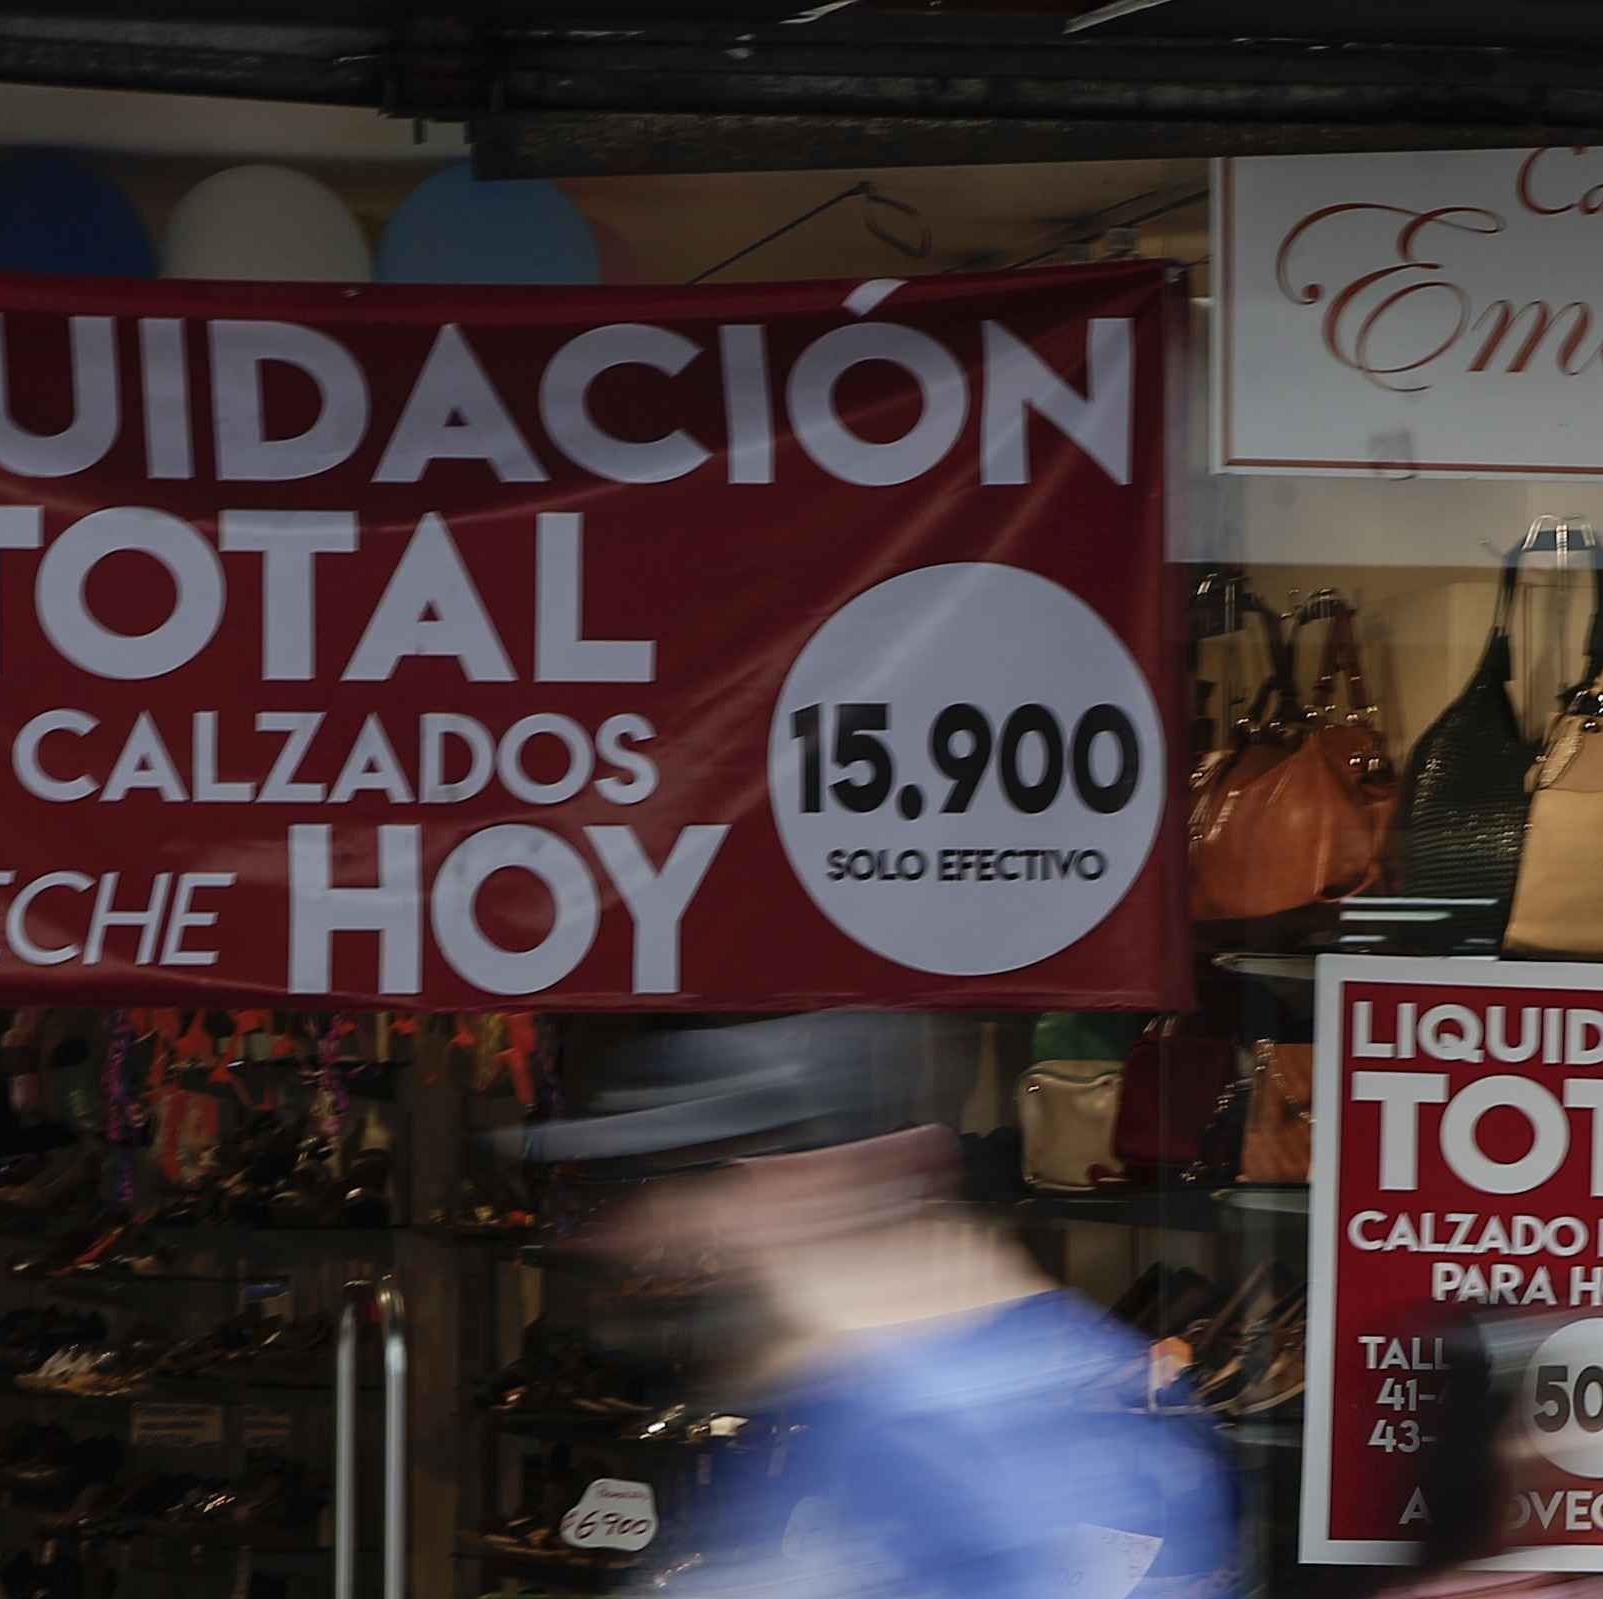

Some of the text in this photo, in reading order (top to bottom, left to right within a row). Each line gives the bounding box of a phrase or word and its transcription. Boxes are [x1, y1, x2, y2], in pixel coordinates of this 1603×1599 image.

[11, 708, 660, 806] CALZADOS
[825, 847, 1107, 883] SOLO EFECTIVO
[287, 822, 731, 996] HOY
[1347, 1210, 1590, 1257] CALZADO
[1432, 1262, 1558, 1305] PARA
[1358, 1335, 1452, 1371] TALL
